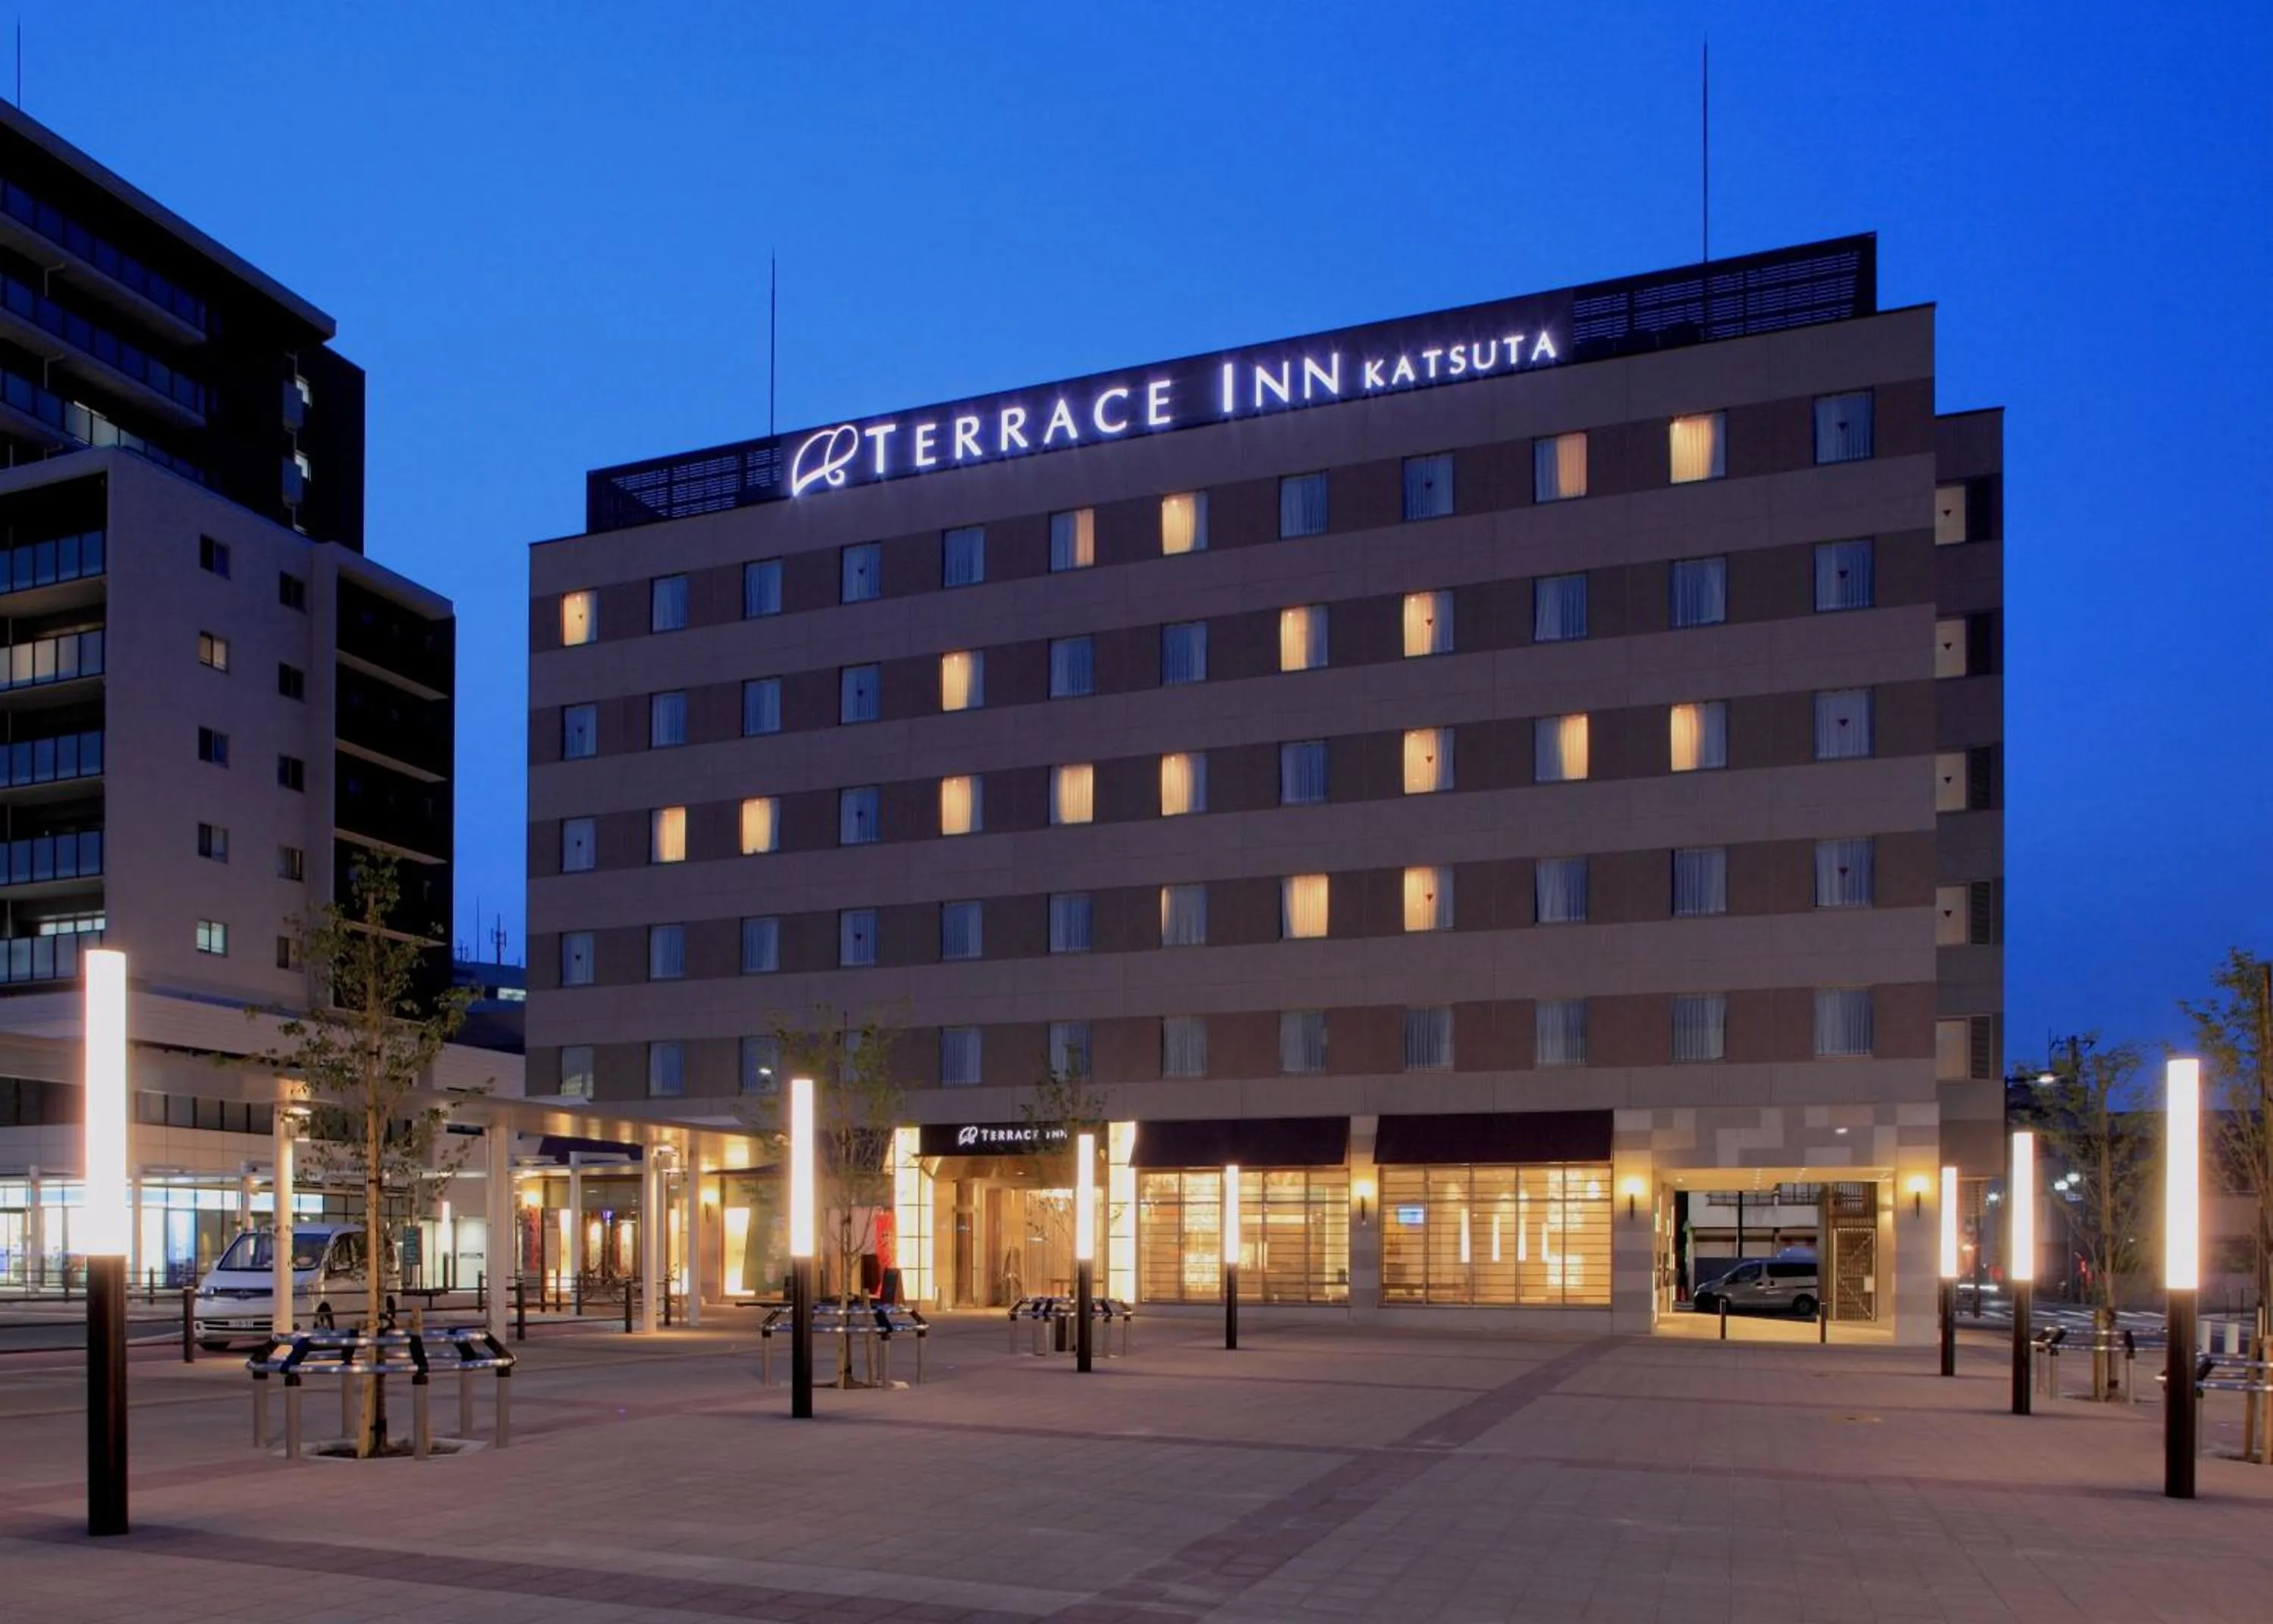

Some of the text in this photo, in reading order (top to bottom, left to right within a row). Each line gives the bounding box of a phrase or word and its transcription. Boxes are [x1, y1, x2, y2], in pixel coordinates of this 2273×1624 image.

[864, 330, 1557, 474] TERRACE INN KATSUTA
